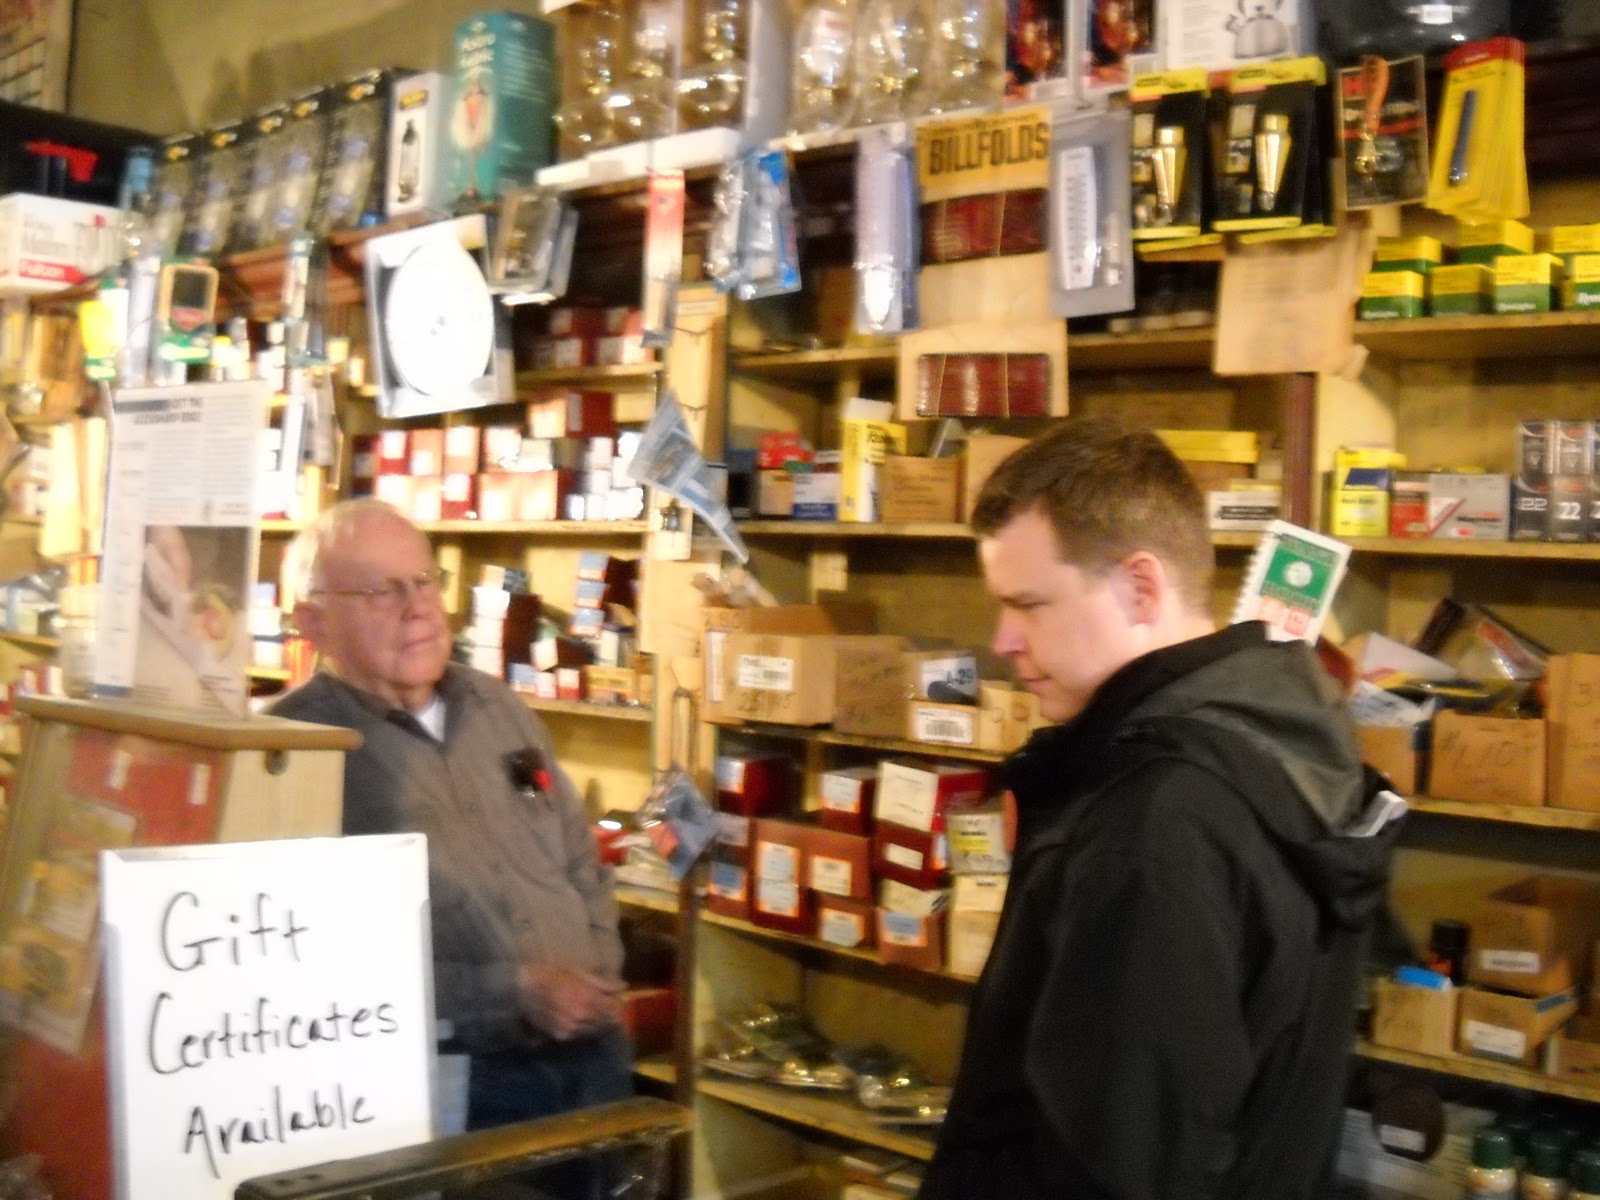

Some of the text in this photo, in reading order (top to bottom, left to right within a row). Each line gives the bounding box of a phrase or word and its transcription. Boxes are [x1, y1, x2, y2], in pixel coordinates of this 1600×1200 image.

[929, 122, 1049, 176] BILLFOLDS
[1557, 501, 1581, 519] 22
[161, 890, 310, 972] Gift
[149, 991, 399, 1075] Certificates
[183, 1082, 376, 1180] Available
